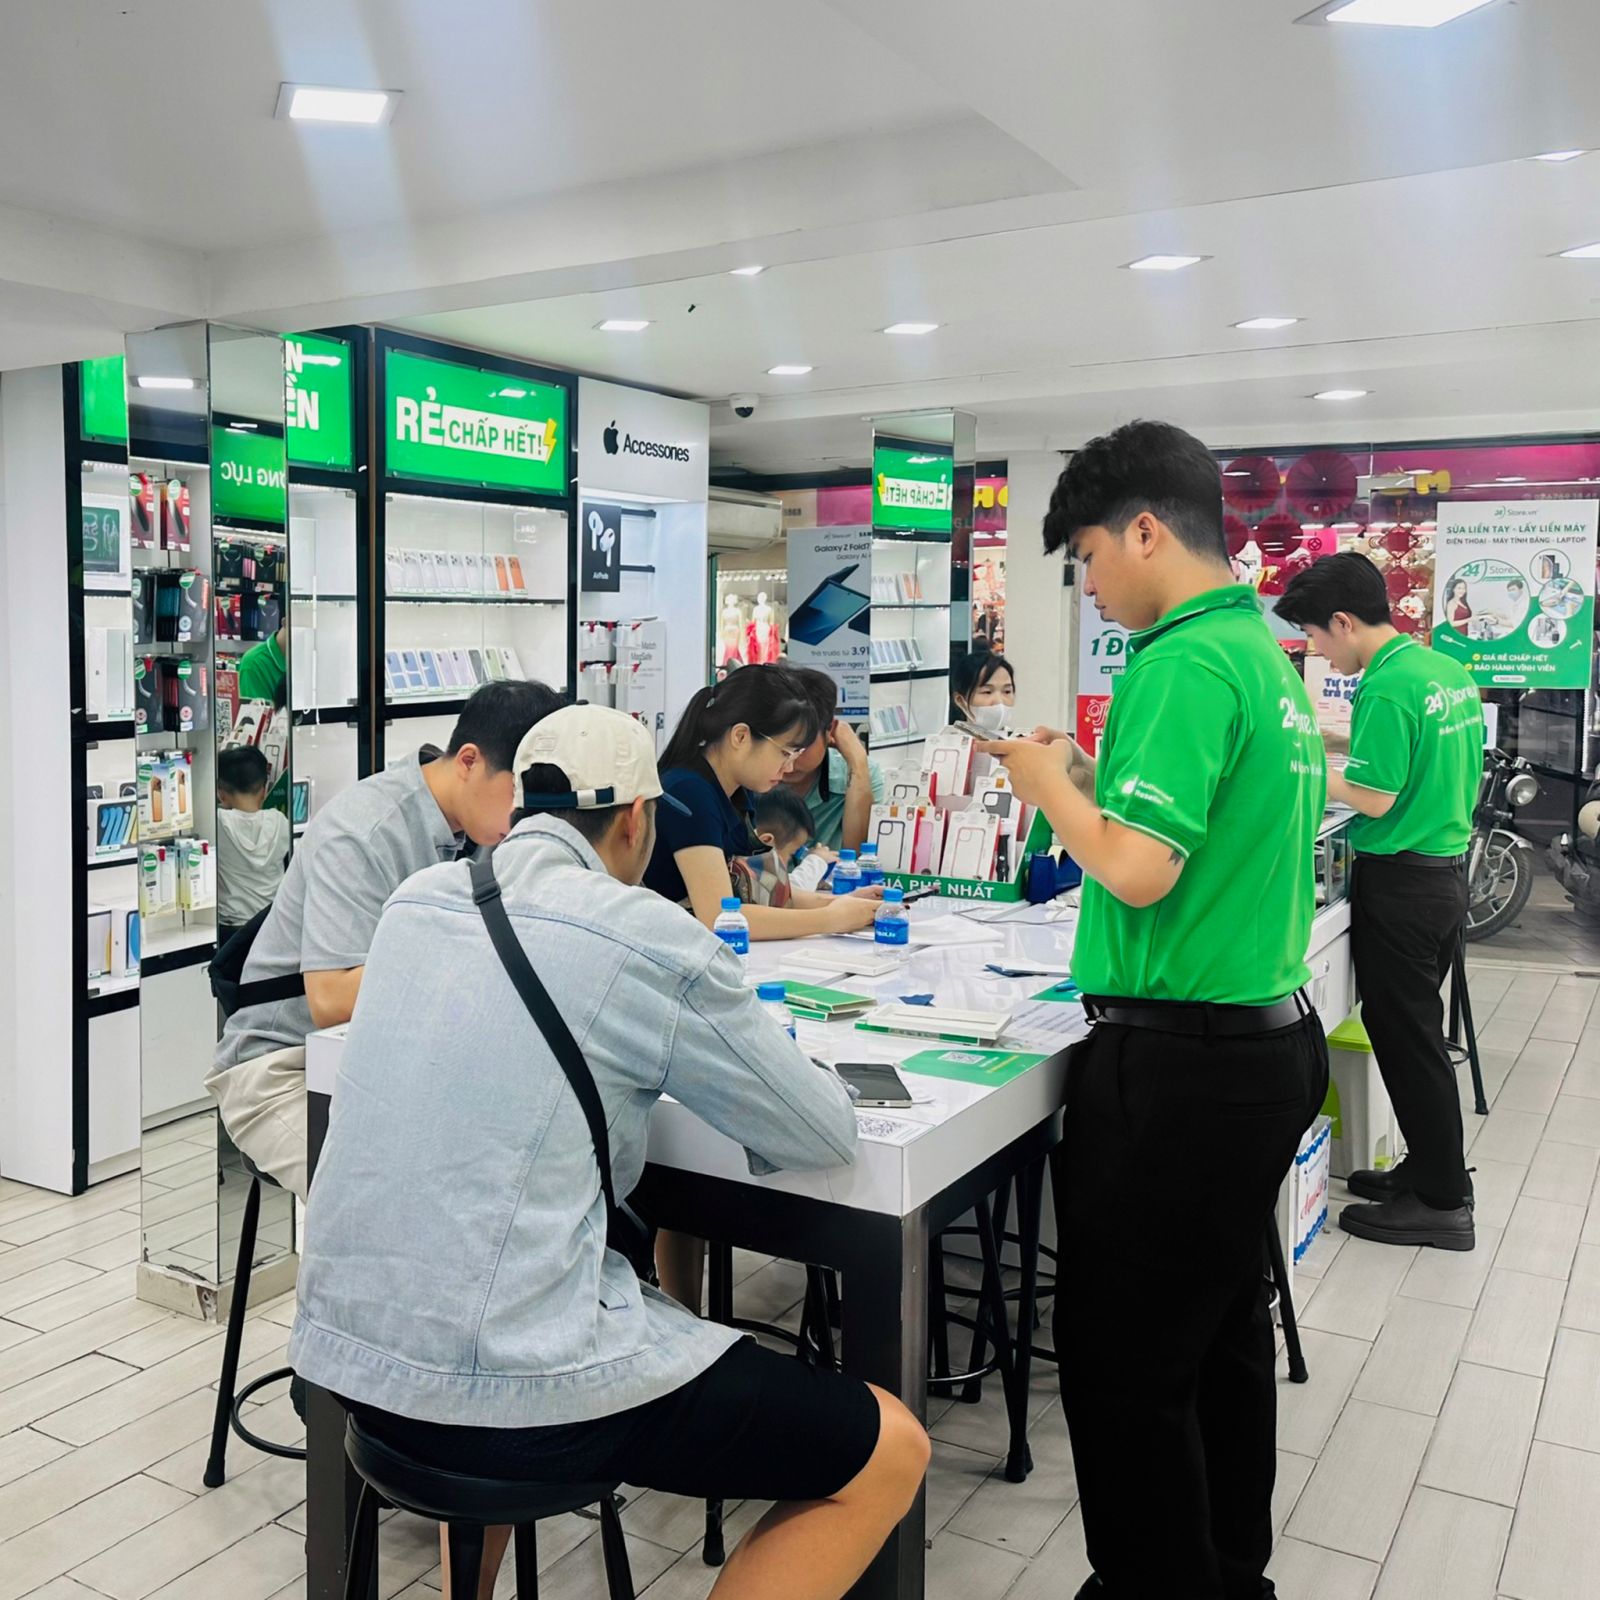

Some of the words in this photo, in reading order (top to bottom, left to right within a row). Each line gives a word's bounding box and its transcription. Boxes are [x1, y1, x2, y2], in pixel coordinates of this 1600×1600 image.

[396, 386, 446, 446] RẺ
[449, 417, 499, 449] CHẤP
[504, 424, 543, 456] HẾT!
[623, 433, 690, 462] Accessories
[1492, 525, 1510, 533] TAY
[814, 545, 842, 553] Galaxy
[1557, 536, 1586, 544] LAPTOP
[1425, 691, 1443, 715] 24
[947, 881, 995, 899] NHẤT
